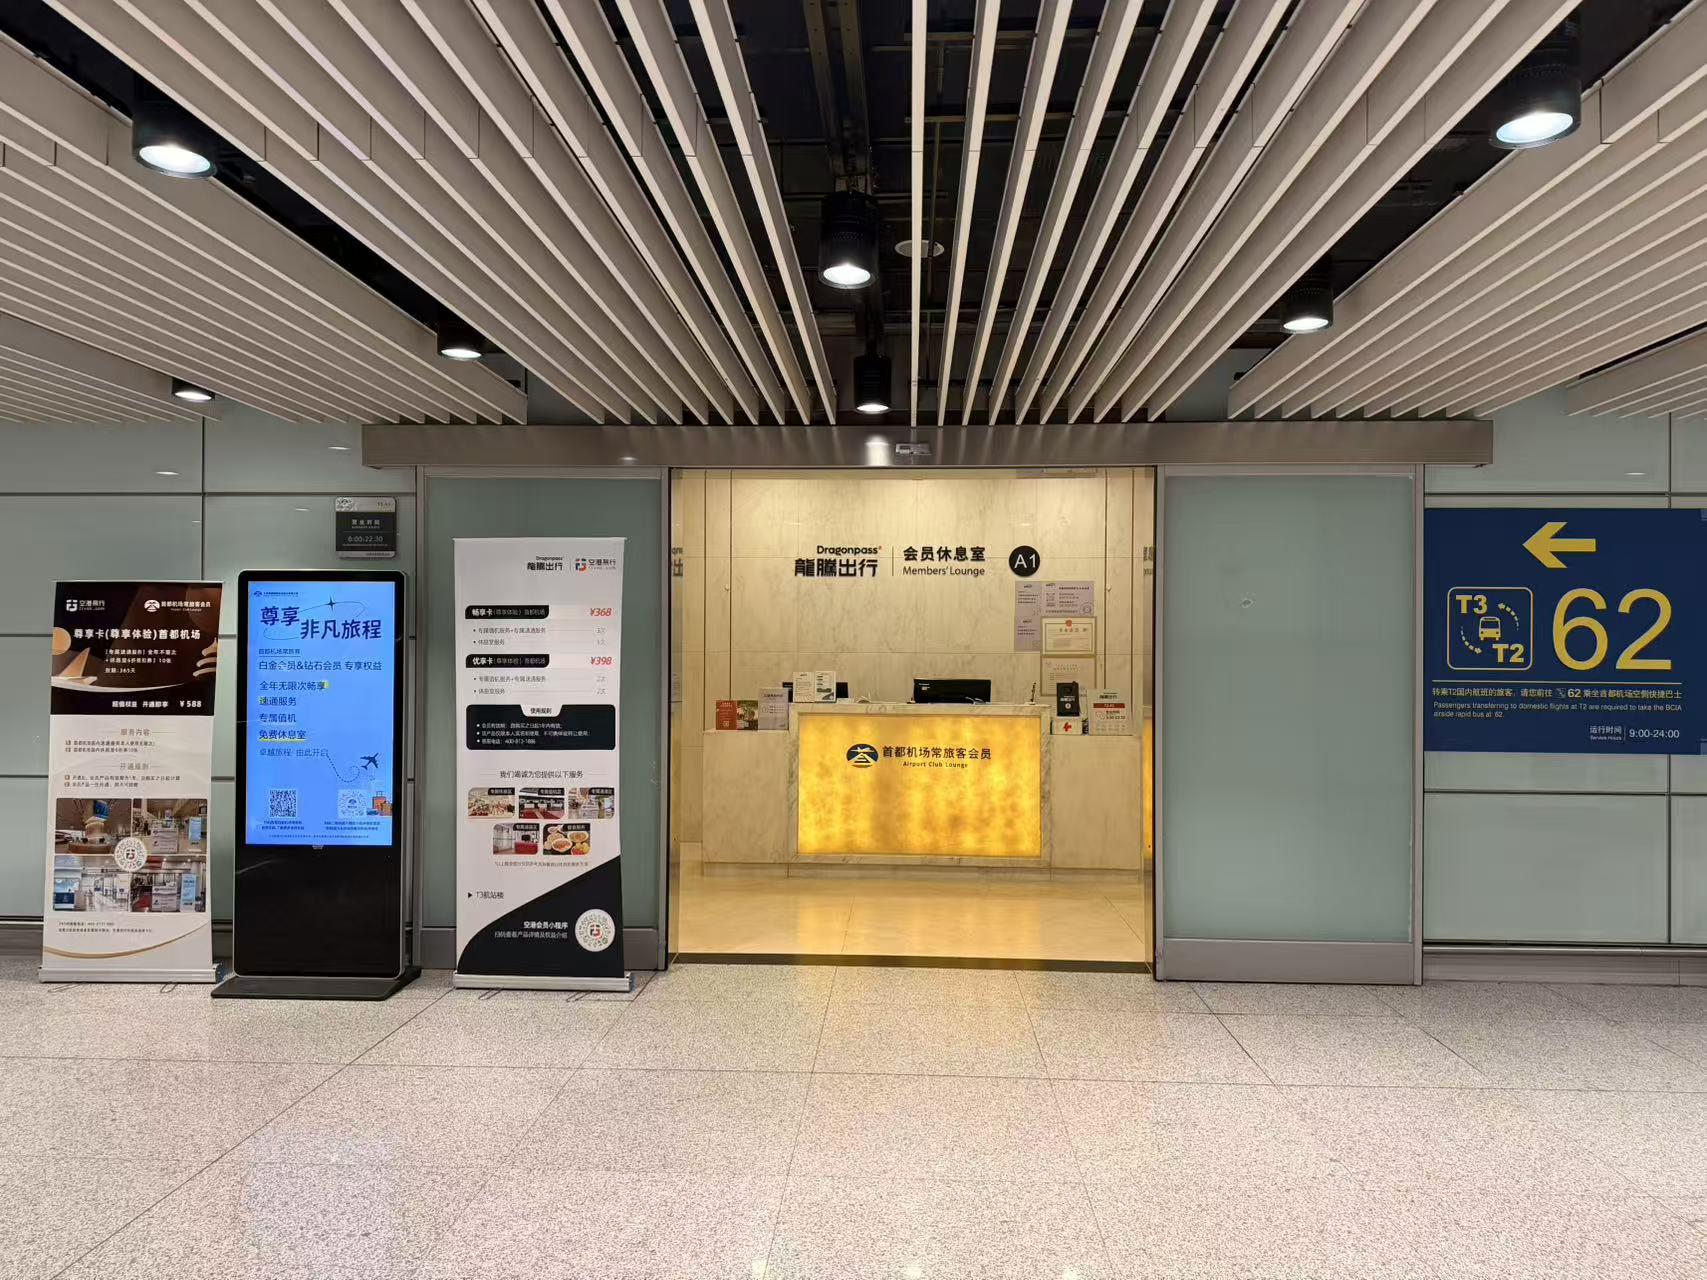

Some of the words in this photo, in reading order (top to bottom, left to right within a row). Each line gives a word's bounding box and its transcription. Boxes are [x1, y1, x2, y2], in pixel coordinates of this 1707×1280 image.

[817, 545, 878, 555] Dragonpass
[903, 546, 986, 562] 会员休息室
[1014, 553, 1036, 569] A1
[794, 558, 878, 577] 龍騰出行
[950, 566, 985, 577] Lounge
[1455, 595, 1488, 615] T3
[260, 606, 300, 626] 尊享
[589, 607, 613, 617] ¥368
[301, 619, 382, 640] 非凡旅程
[1553, 588, 1672, 671] 62
[1492, 644, 1525, 663] T2
[259, 661, 342, 671] 白金会员&钻石会员
[345, 661, 382, 671] 专享权益
[590, 656, 613, 666] ¥398
[259, 681, 326, 691] 全年无限次畅享
[1567, 689, 1581, 698] 62
[259, 696, 297, 706] 速通服务
[1433, 701, 1471, 711] Passengers
[1472, 701, 1508, 711] transferring
[1519, 702, 1549, 710] domestic
[1550, 702, 1569, 711] flights
[1601, 703, 1628, 712] required
[259, 713, 296, 723] 专属值机
[1455, 711, 1471, 719] rapid
[259, 729, 306, 740] 免费休息室
[1590, 725, 1622, 734] 运行时间
[1629, 729, 1680, 739] 9:00-24:00
[296, 748, 329, 757] 由此开启
[883, 746, 991, 760] 首都机场常旅客会员
[903, 761, 926, 769] Airport
[945, 761, 968, 769] Lounge
[476, 890, 504, 899] T3航站楼
[523, 921, 569, 929] 空港会员小程序
